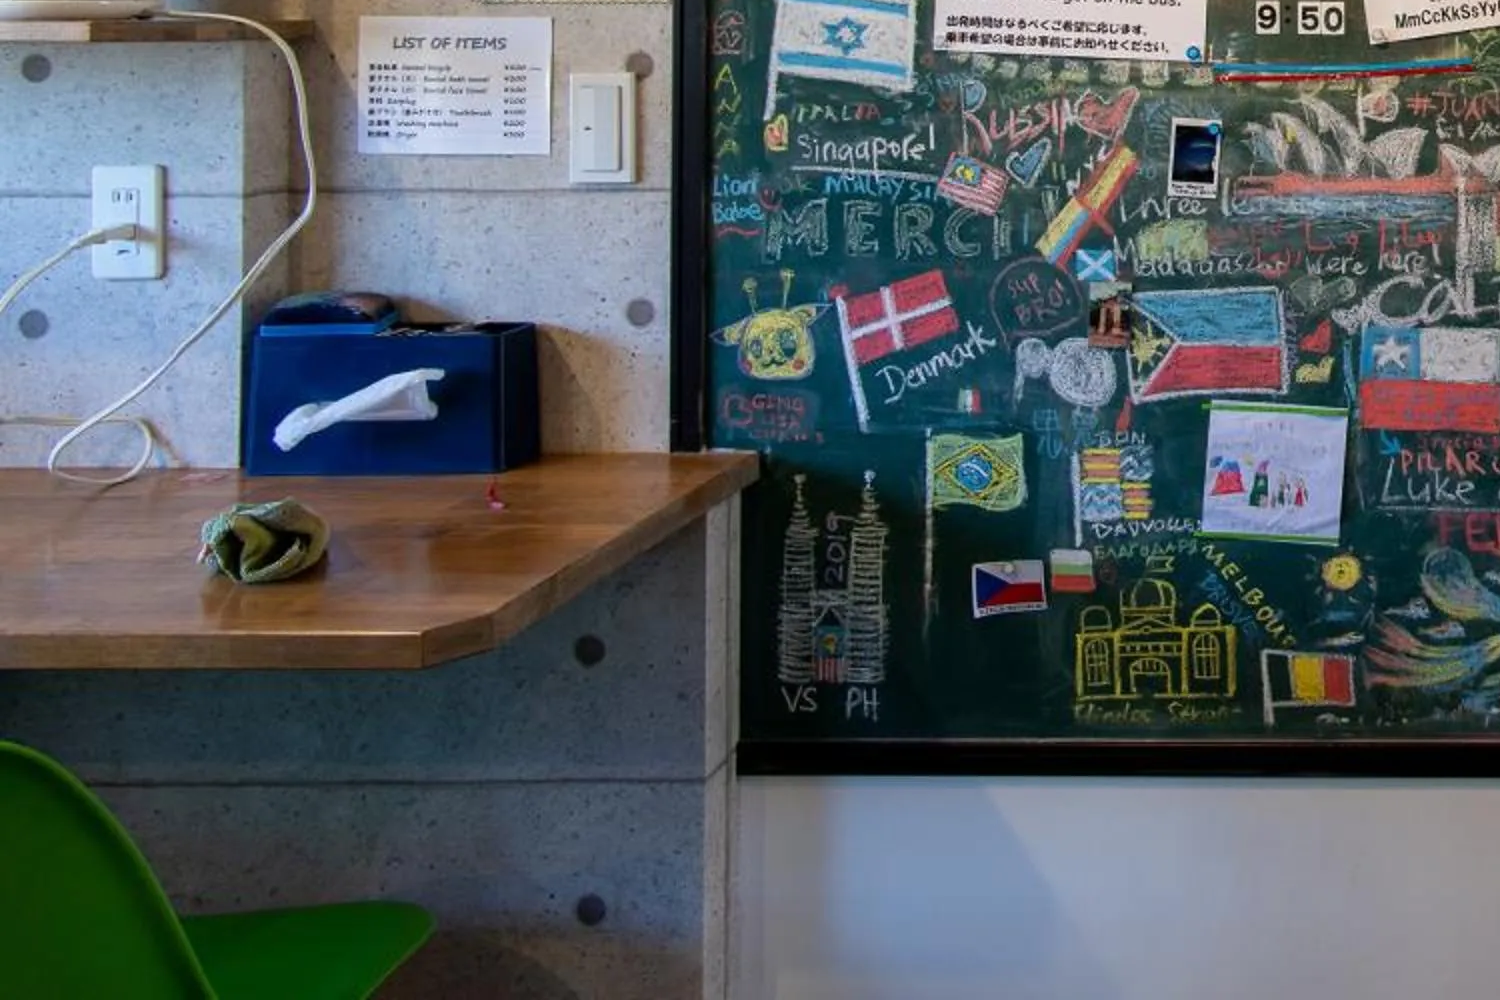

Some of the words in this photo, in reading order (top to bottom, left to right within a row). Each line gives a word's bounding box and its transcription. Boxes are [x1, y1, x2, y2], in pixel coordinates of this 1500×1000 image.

[1258, 5, 1343, 32] 9:50
[393, 36, 427, 51] LIST
[430, 36, 452, 51] OF
[455, 37, 508, 51] ITEMS
[875, 319, 998, 404] Denmark
[1380, 457, 1477, 506] Luke
[780, 686, 819, 714] VS
[845, 686, 881, 723] PH
